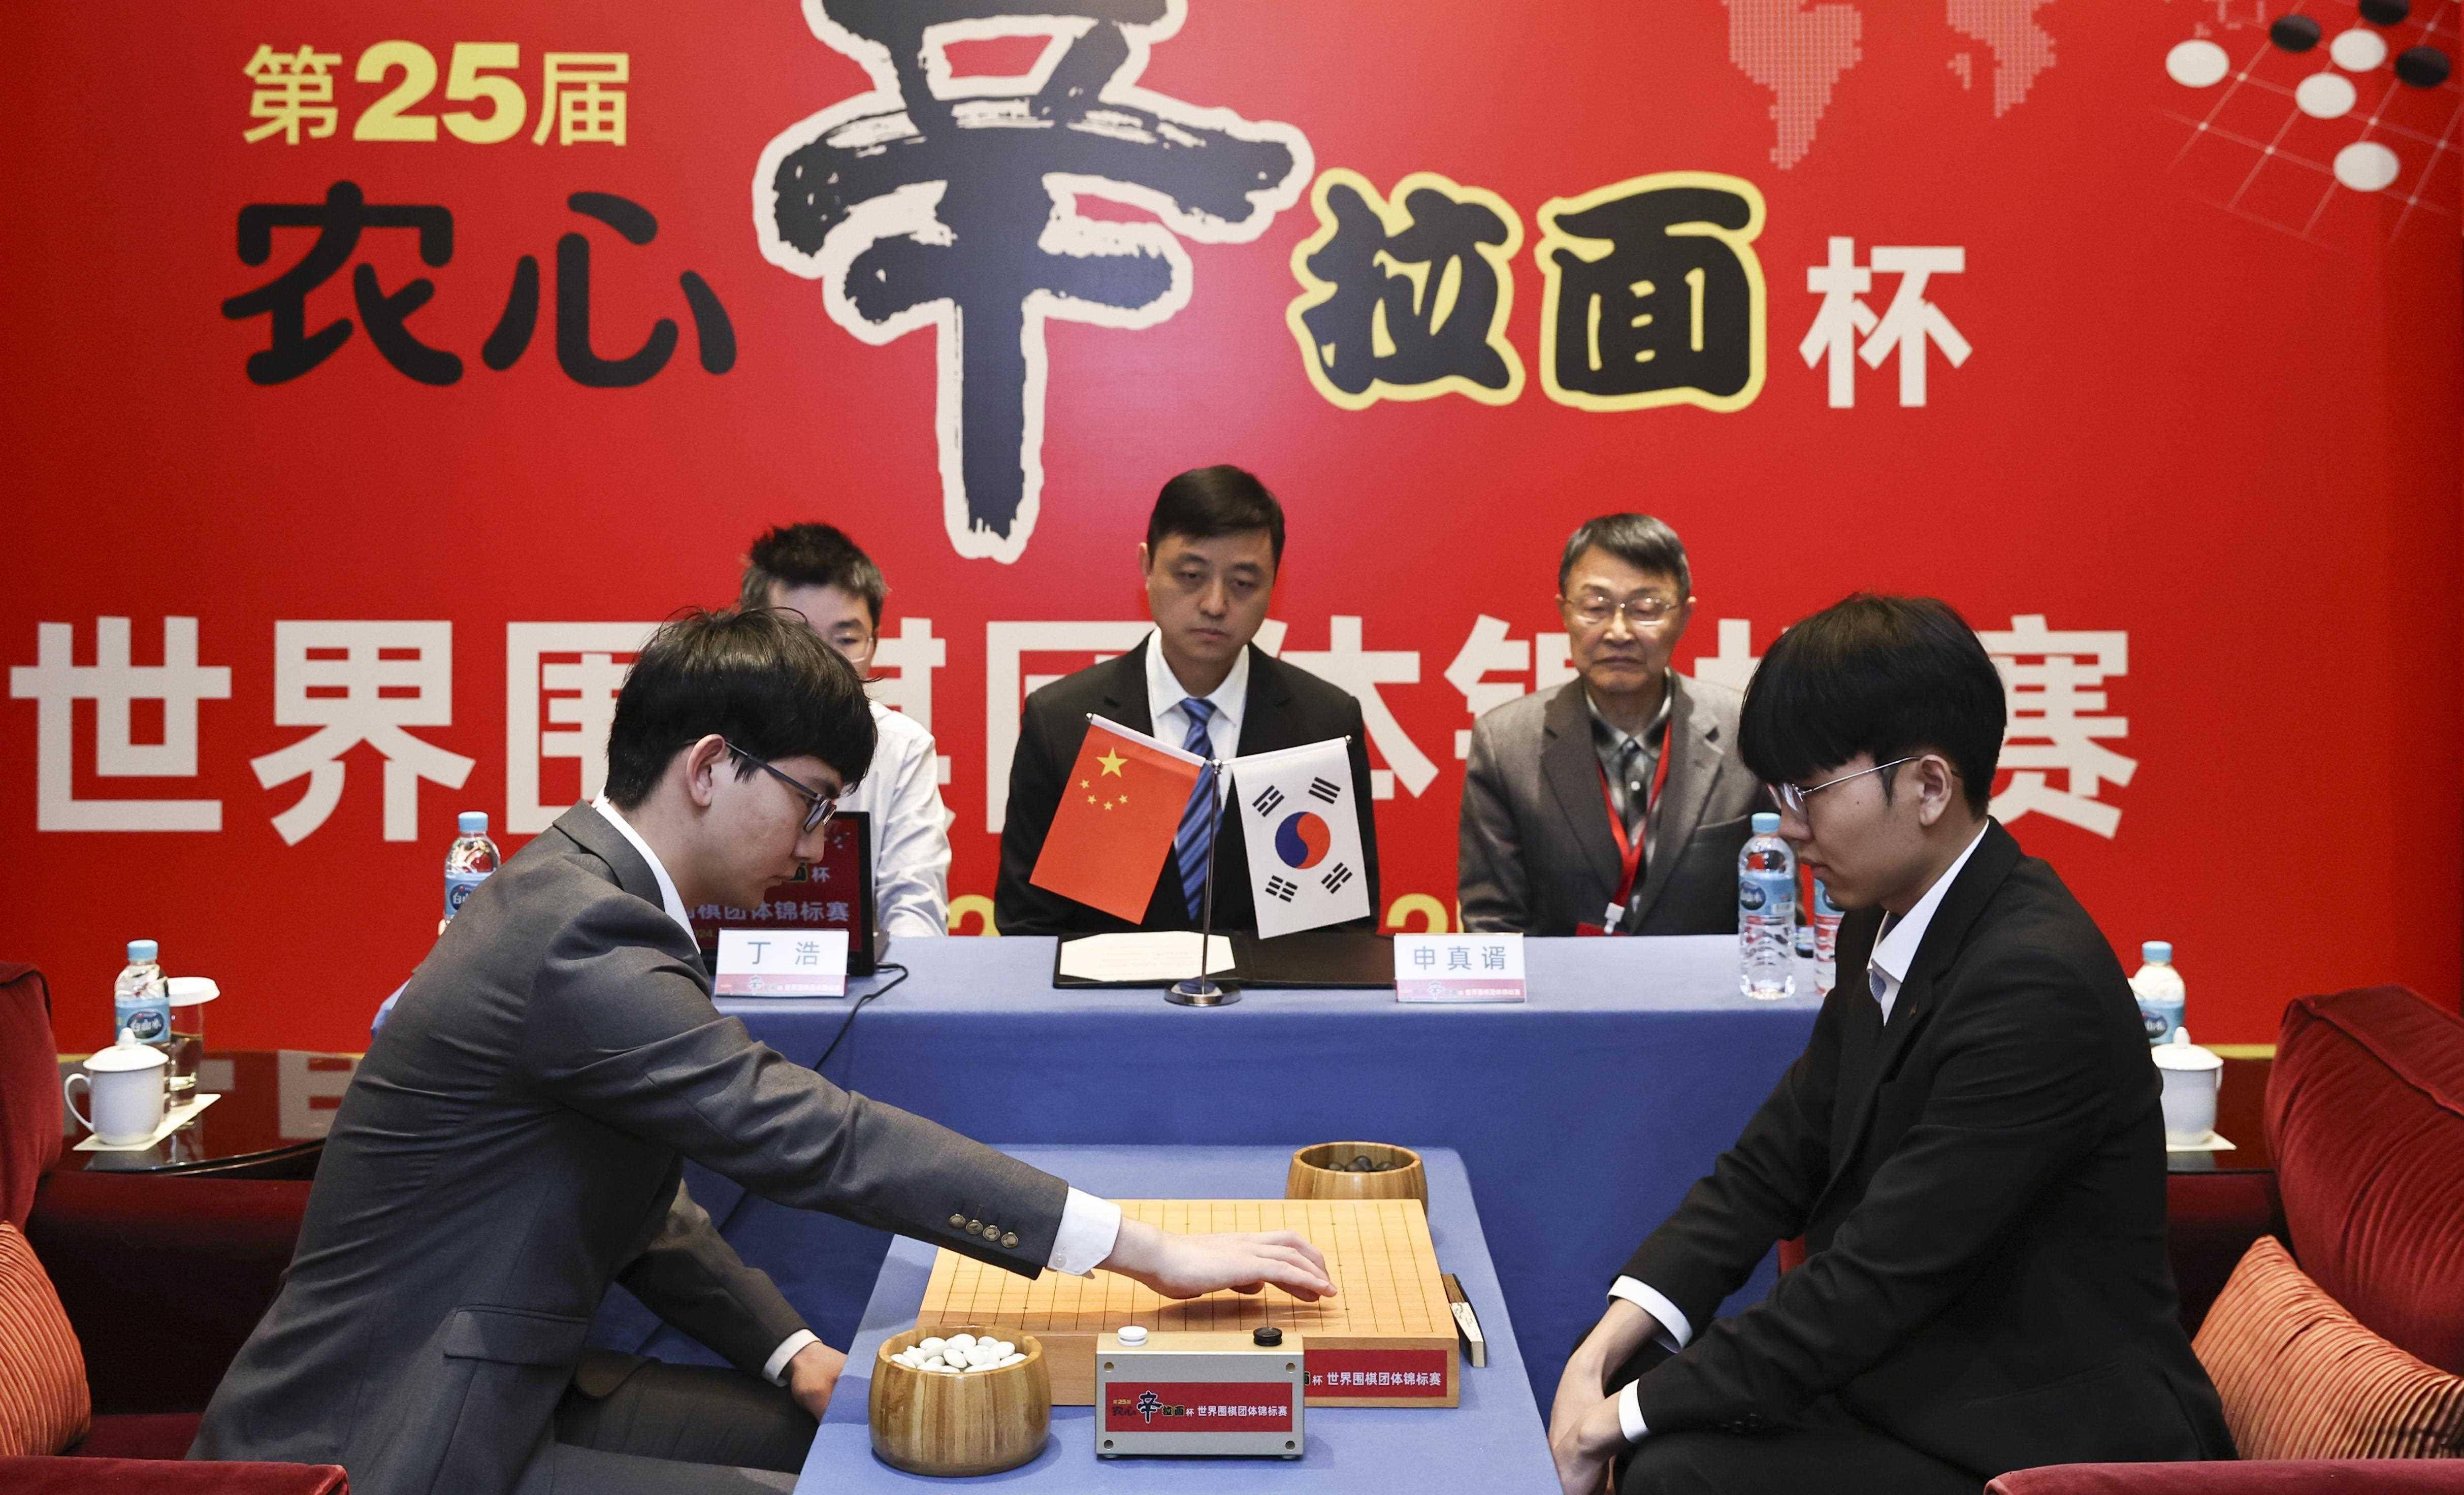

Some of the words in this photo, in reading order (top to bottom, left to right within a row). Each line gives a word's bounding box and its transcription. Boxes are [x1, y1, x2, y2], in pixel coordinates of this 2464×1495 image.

[242, 40, 630, 146] 第25届
[221, 180, 737, 387] 农心
[752, 0, 1315, 564] 辛
[1285, 168, 1767, 412] 拉面
[1799, 236, 1973, 408] 杯
[686, 901, 849, 922] 棋团体锦标赛
[748, 941, 820, 965] 丁浩
[1414, 946, 1506, 970] 申真谞
[1312, 1375, 1323, 1386] 杯
[1327, 1372, 1441, 1386] 世界围棋团体锦标赛
[1137, 1390, 1163, 1424] 辛
[1186, 1408, 1194, 1417] 杯
[1197, 1406, 1288, 1417] 世界围棋团体锦标赛
